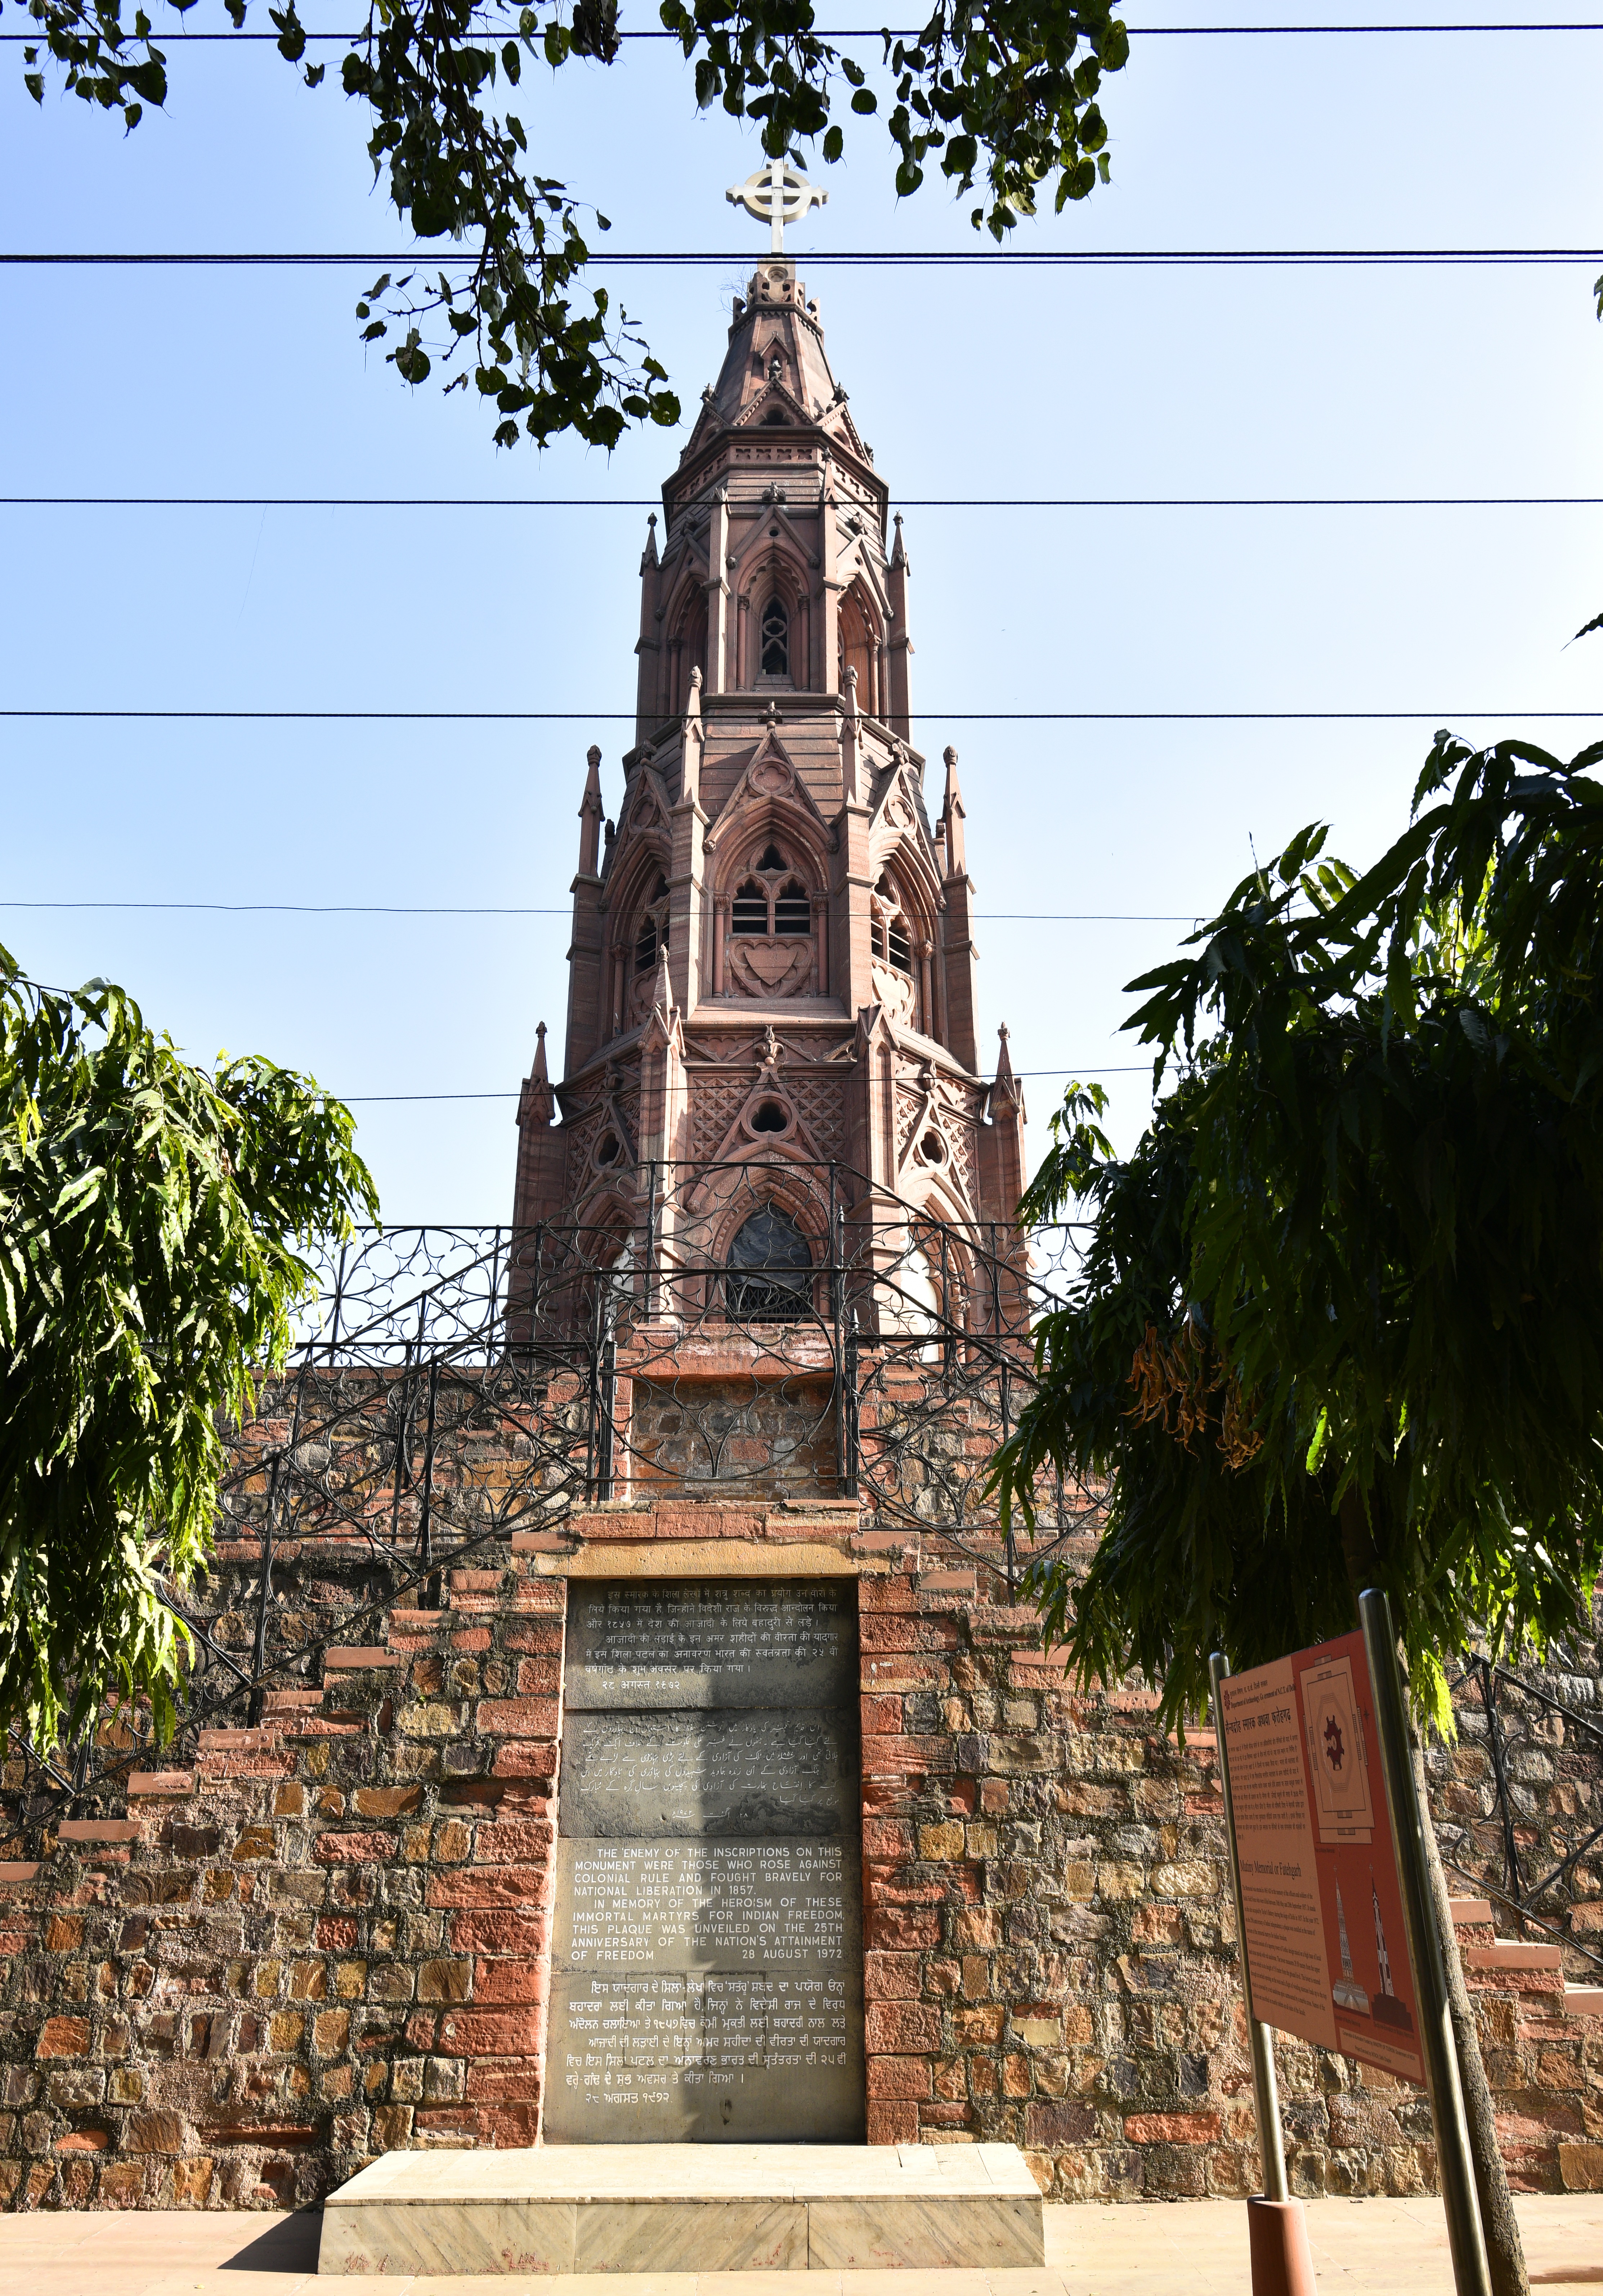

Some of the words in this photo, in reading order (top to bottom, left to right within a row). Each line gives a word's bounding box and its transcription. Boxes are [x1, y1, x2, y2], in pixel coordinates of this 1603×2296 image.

[607, 1591, 620, 1600] इस
[652, 1589, 659, 1598] के
[662, 1589, 680, 1599] शिला
[683, 1588, 701, 1599] लेखों
[715, 1590, 728, 1601] शत्रु
[733, 1589, 751, 1598] शब्द
[771, 1587, 792, 1597] प्रयोग
[810, 1588, 825, 1598] वीरों
[829, 1587, 837, 1598] के
[587, 1604, 605, 1614] लिये
[608, 1604, 630, 1614] किया
[667, 1603, 695, 1614] जिन्होंने
[698, 1602, 722, 1613] विदेशी
[744, 1602, 751, 1612] के
[754, 1602, 778, 1613] विरुद्ध
[781, 1602, 815, 1612] आन्दोलन
[818, 1602, 838, 1612] किया
[638, 1633, 650, 1643] की
[654, 1633, 676, 1644] लड़ाई
[678, 1633, 685, 1643] के
[689, 1635, 701, 1644] इन
[730, 1632, 758, 1643] शहीदों
[760, 1632, 771, 1642] की
[774, 1632, 797, 1642] वीरता
[800, 1631, 811, 1641] की
[813, 1633, 838, 1642] यादगार
[602, 1681, 615, 1691] २८
[620, 1681, 652, 1690] अगस्त
[1225, 1717, 1241, 1735] सैन्यद्रोह
[1242, 1717, 1255, 1731] स्मारक
[1257, 1714, 1270, 1727] अथवा
[597, 1849, 618, 1858] THE
[665, 1848, 681, 1857] OF
[687, 1848, 708, 1857] THE
[714, 1847, 790, 1857] INSCRIPTIONS
[796, 1847, 812, 1856] ON
[818, 1847, 842, 1856] THIS
[575, 1861, 636, 1870] MONUMENT
[644, 1861, 674, 1870] WERE
[682, 1860, 719, 1870] THOSE
[727, 1860, 752, 1869] WHO
[760, 1859, 791, 1869] ROSE
[799, 1859, 842, 1869] AGAINST
[1240, 1859, 1253, 1876] Mutiny
[1254, 1861, 1273, 1874] Memorial
[1274, 1866, 1279, 1875] or
[1279, 1862, 1302, 1880] Fatehgarh
[575, 1873, 631, 1883] COLONIAL
[641, 1873, 670, 1883] RULE
[679, 1872, 701, 1883] AND
[711, 1872, 756, 1882] FOUGHT
[765, 1872, 811, 1881] BRAVELY
[820, 1872, 842, 1881] FOR
[574, 1886, 627, 1896] NATIONAL
[636, 1885, 702, 1896] LIBERATION
[711, 1885, 721, 1895] IN
[729, 1885, 756, 1895] 1857.
[594, 1899, 605, 1908] IN
[613, 1898, 661, 1909] MEMORY
[668, 1898, 684, 1908] OF
[692, 1898, 713, 1908] THE
[722, 1898, 772, 1908] HEROISM
[780, 1897, 797, 1907] OF
[805, 1897, 842, 1907] THESE
[573, 1912, 633, 1921] IMMORTAL
[643, 1911, 699, 1921] MARTYRS
[709, 1911, 733, 1920] FOR
[743, 1910, 779, 1920] INDIAN
[788, 1910, 845, 1921] FREEDOM,
[573, 1924, 598, 1934] THIS
[608, 1924, 653, 1935] PLAQUE
[661, 1924, 685, 1934] WAS
[695, 1924, 750, 1933] UNVEILED
[759, 1923, 775, 1933] ON
[784, 1923, 805, 1933] THE
[572, 1937, 649, 1947] ANNIVERSARY
[658, 1937, 675, 1946] OF
[684, 1937, 707, 1946] THE
[716, 1935, 767, 1946] NATION'S
[774, 1935, 842, 1946] ATTAINMENT
[571, 1951, 588, 1960] OF
[596, 1950, 656, 1960] FREEDOM.
[742, 1949, 755, 1959] 28
[763, 1948, 809, 1959] AUGUST
[817, 1948, 842, 1959] 1972
[609, 1999, 629, 2011] ਲਈ
[635, 1998, 655, 2011] ਕੀਤਾ
[662, 1999, 686, 2011] ਗਿਆ
[735, 1997, 744, 2010] ਨੇ
[784, 2000, 801, 2010] ਰਾਜ
[808, 1997, 816, 2010] ਦੇ
[619, 2035, 629, 2047] ਦੀ
[632, 2035, 658, 2049] ਲੜਾਈ
[662, 2035, 670, 2047] ਦੇ
[755, 2034, 765, 2046] ਦੀ
[769, 2034, 796, 2046] ਵੀਰਤਾ
[799, 2034, 808, 2046] ਦੀ
[812, 2036, 846, 2046] ਯਾਦਗਾਰ
[604, 2093, 639, 2104] ਅਗਸਤ
